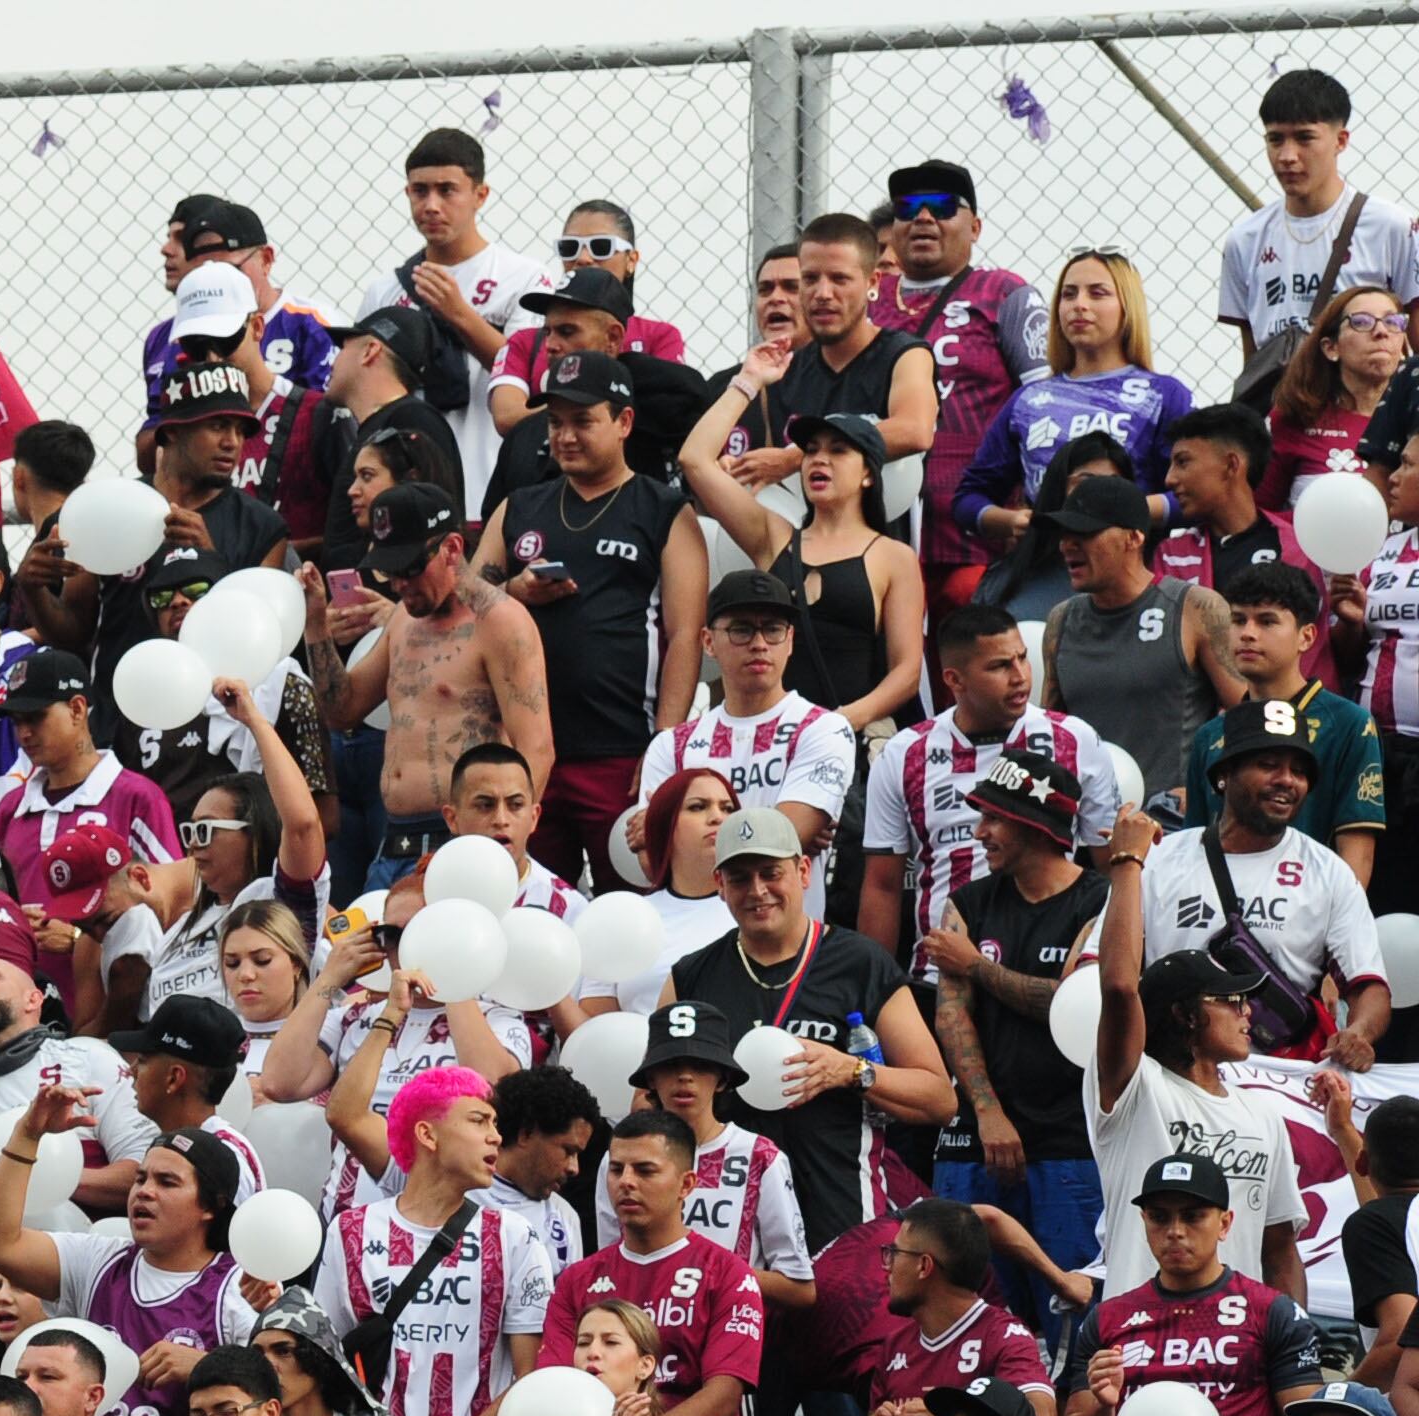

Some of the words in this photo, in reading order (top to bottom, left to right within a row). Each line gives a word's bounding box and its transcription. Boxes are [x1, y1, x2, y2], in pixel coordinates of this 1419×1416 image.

[265, 338, 294, 374] S
[1068, 412, 1132, 443] BAC
[1138, 608, 1166, 642] S
[1263, 700, 1297, 734] S
[730, 758, 783, 794] BAC
[1277, 861, 1304, 886] S
[1240, 897, 1287, 922] BAC
[669, 1005, 696, 1038] S
[721, 1156, 747, 1188] S
[406, 1276, 471, 1307] BAC
[671, 1268, 702, 1299] S
[643, 1299, 695, 1329] ölbi
[1218, 1295, 1248, 1328] S
[957, 1339, 982, 1374] S
[1162, 1335, 1240, 1366] BAC
[965, 1377, 990, 1397] S
